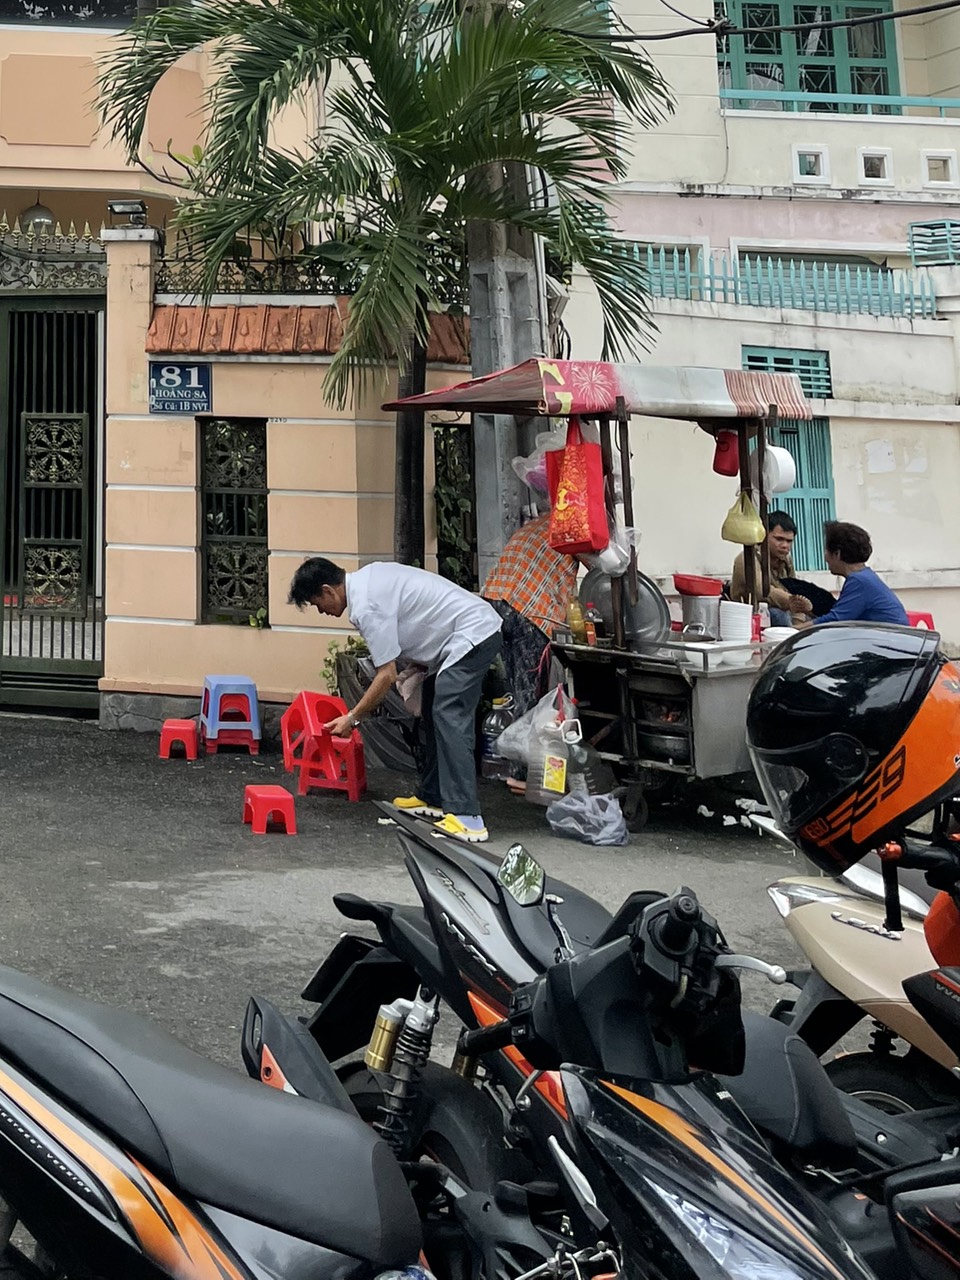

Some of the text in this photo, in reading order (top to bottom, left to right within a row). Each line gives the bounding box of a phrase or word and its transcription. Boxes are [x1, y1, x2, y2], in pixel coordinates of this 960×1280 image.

[160, 366, 203, 388] 81
[155, 388, 207, 399] HOÀNG SA
[180, 401, 190, 411] 1B
[192, 402, 208, 411] NVT
